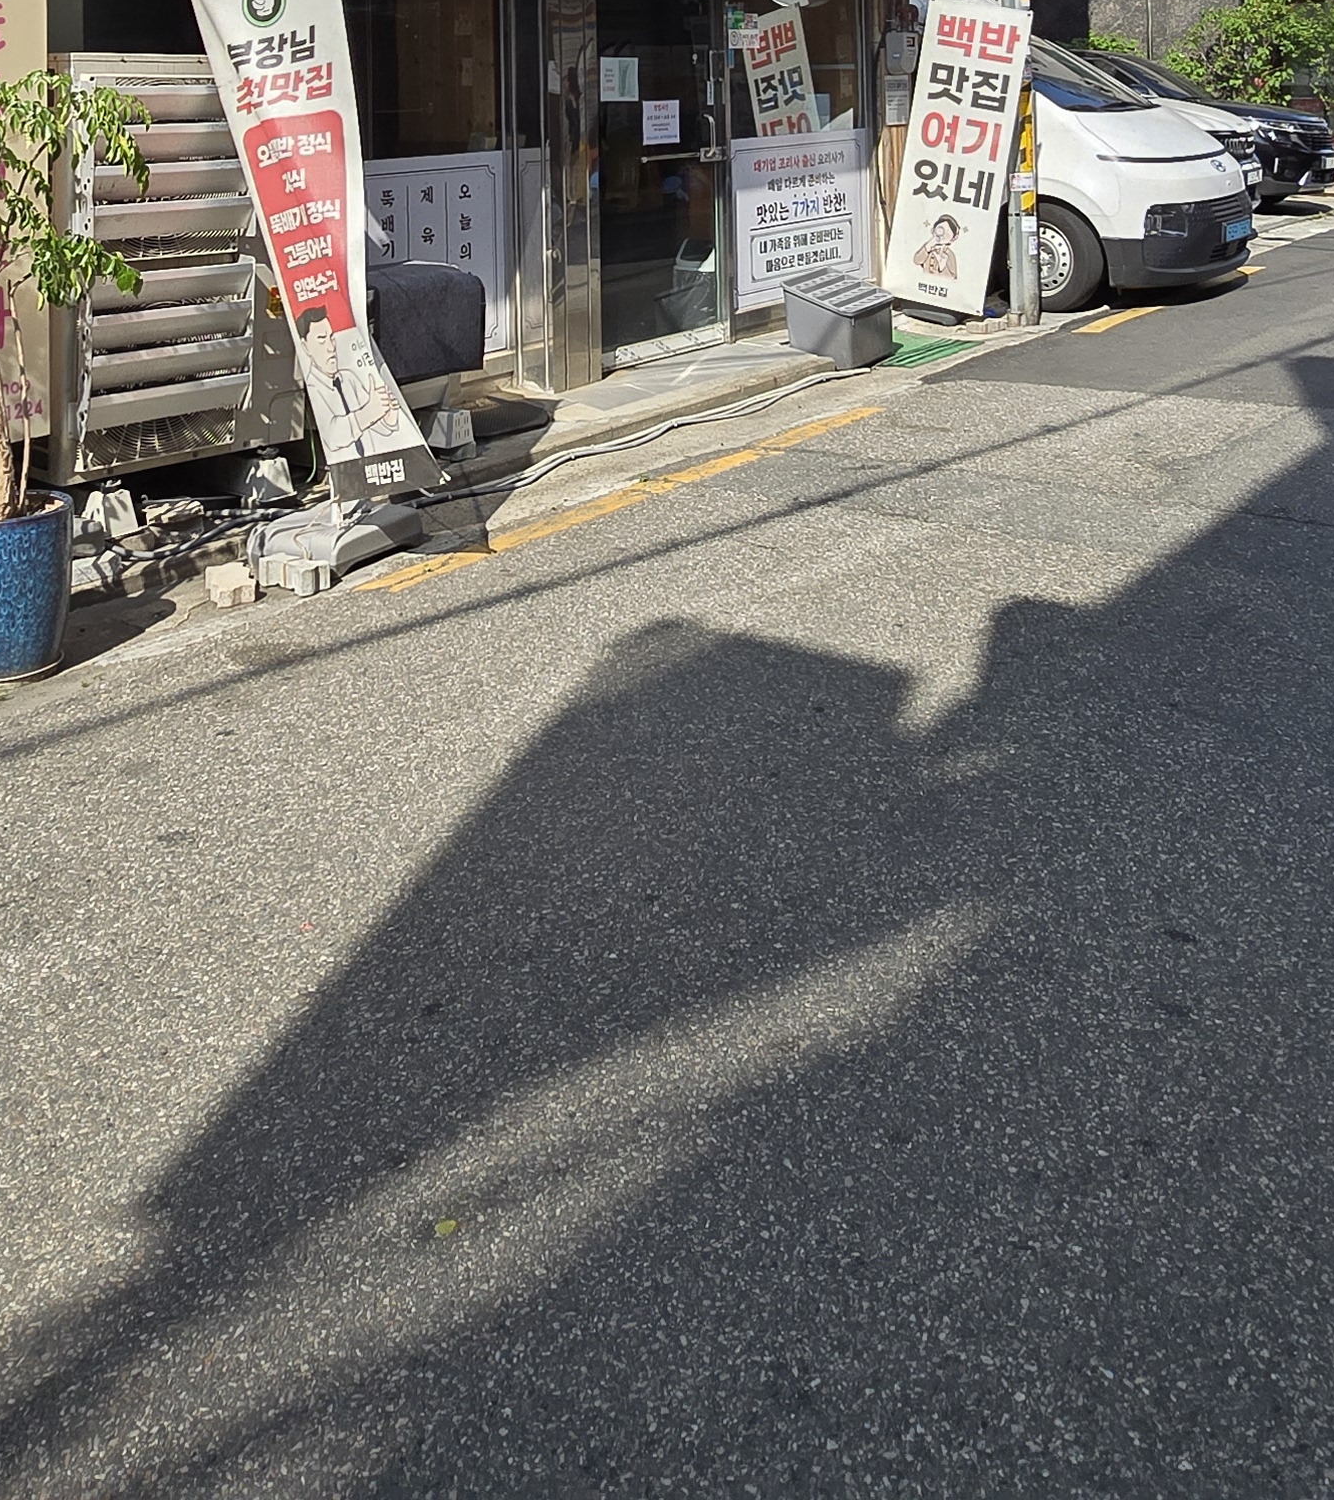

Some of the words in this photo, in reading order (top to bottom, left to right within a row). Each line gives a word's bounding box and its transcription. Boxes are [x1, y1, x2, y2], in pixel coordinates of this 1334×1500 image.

[937, 14, 1020, 64] 백반
[927, 62, 1010, 113] 맛집
[297, 131, 332, 156] 정식
[921, 112, 1002, 163] 여기
[817, 151, 845, 165] 요리사가
[913, 159, 995, 211] 있네
[306, 199, 341, 224] 정식
[380, 190, 395, 259] 뚝배기
[420, 185, 435, 245] 제육
[458, 183, 472, 259] 오늘의
[756, 202, 790, 225] 맛있는
[792, 196, 820, 217] 7가지
[768, 235, 791, 252] 가족을
[792, 233, 808, 248] 위해
[766, 256, 795, 273] 마음으로
[918, 282, 948, 297] 백반집
[365, 458, 406, 486] 백반집
